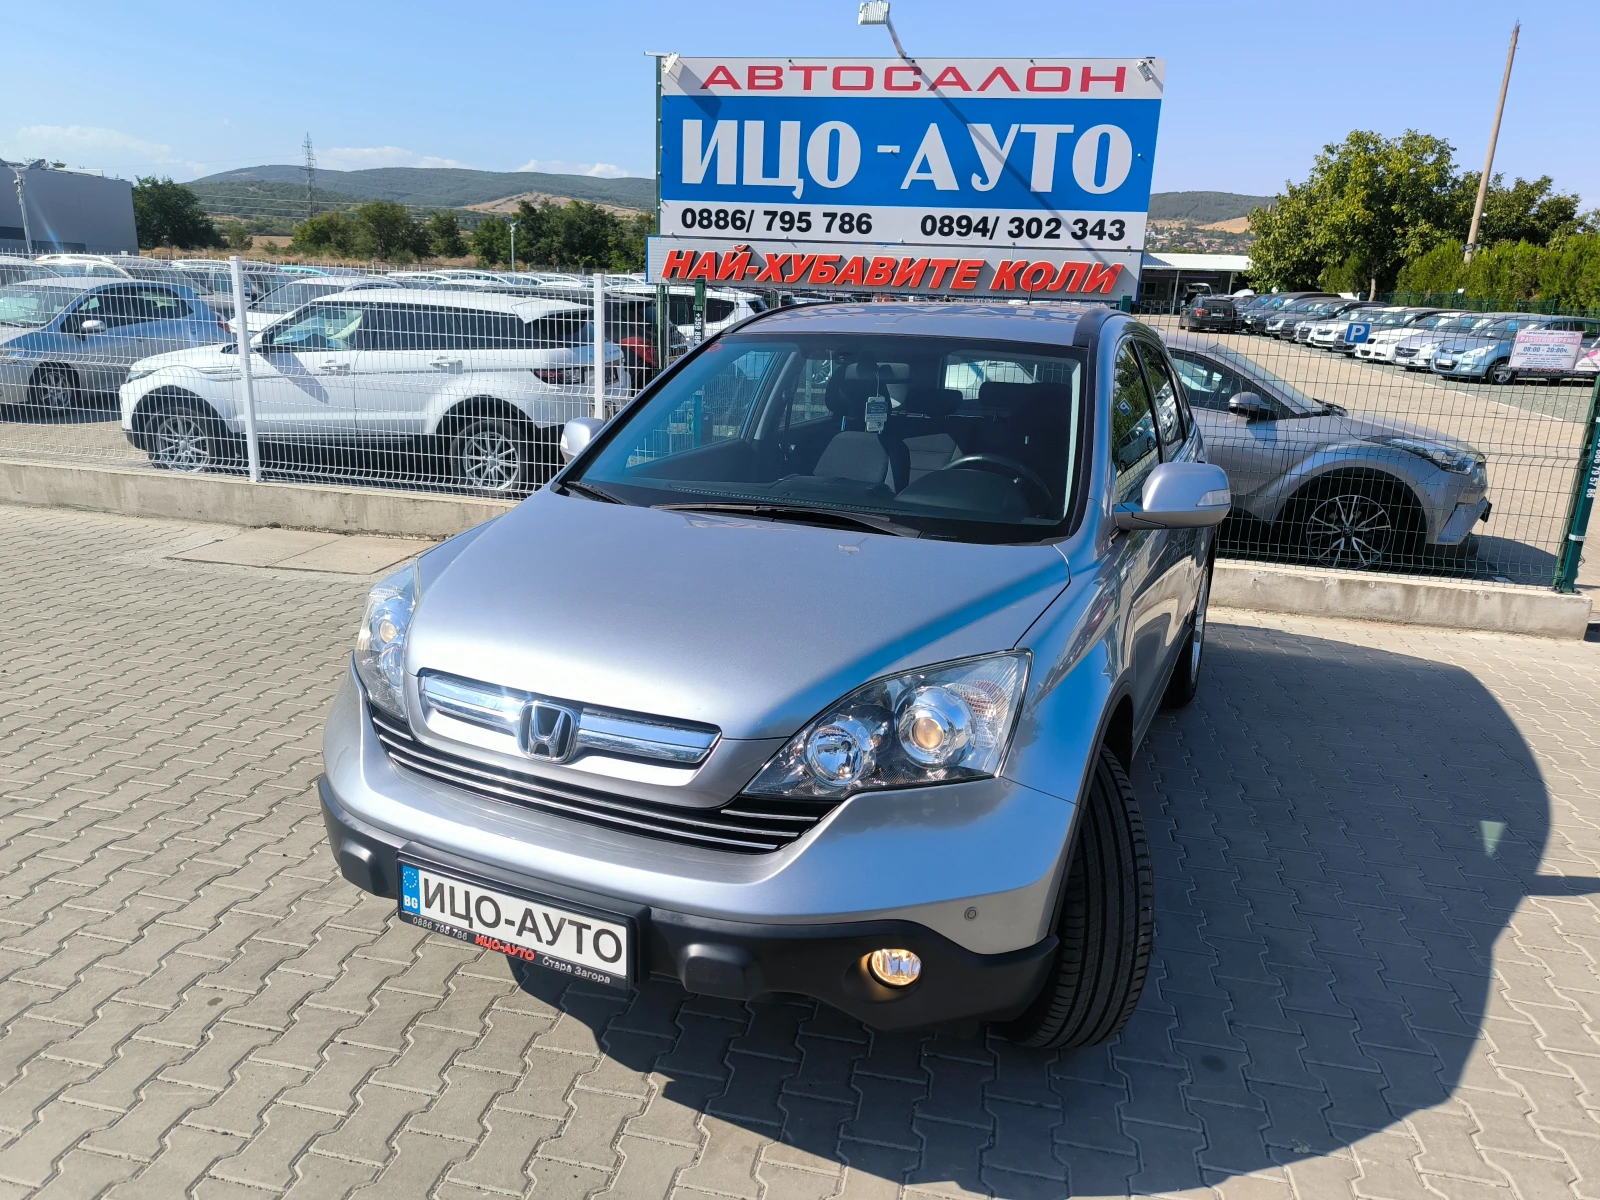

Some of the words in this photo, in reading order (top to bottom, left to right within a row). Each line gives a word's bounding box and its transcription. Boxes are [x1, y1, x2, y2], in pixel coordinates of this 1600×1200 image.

[700, 65, 1127, 93] АВТОСАЛОН
[681, 207, 755, 233] 0886/
[763, 210, 812, 233] 795
[822, 212, 873, 235] 786
[920, 214, 1000, 241] 0894/
[1007, 216, 1062, 240] 302
[1070, 218, 1126, 242] 343
[661, 245, 985, 290] НАЙ-ХУБАВИТЕ
[990, 260, 1123, 295] КОЛИ
[694, 312, 702, 329] +359
[1588, 477, 1597, 487] 57
[1591, 465, 1600, 476] 79
[1586, 488, 1595, 498] 86
[404, 895, 418, 909] BG
[412, 916, 433, 930] 0886
[452, 928, 468, 941] 786
[423, 877, 623, 964] ИЦО-АУТО
[475, 934, 535, 962] ИЦО-АУТО
[542, 956, 572, 973] Стара
[574, 966, 611, 984] Загора
